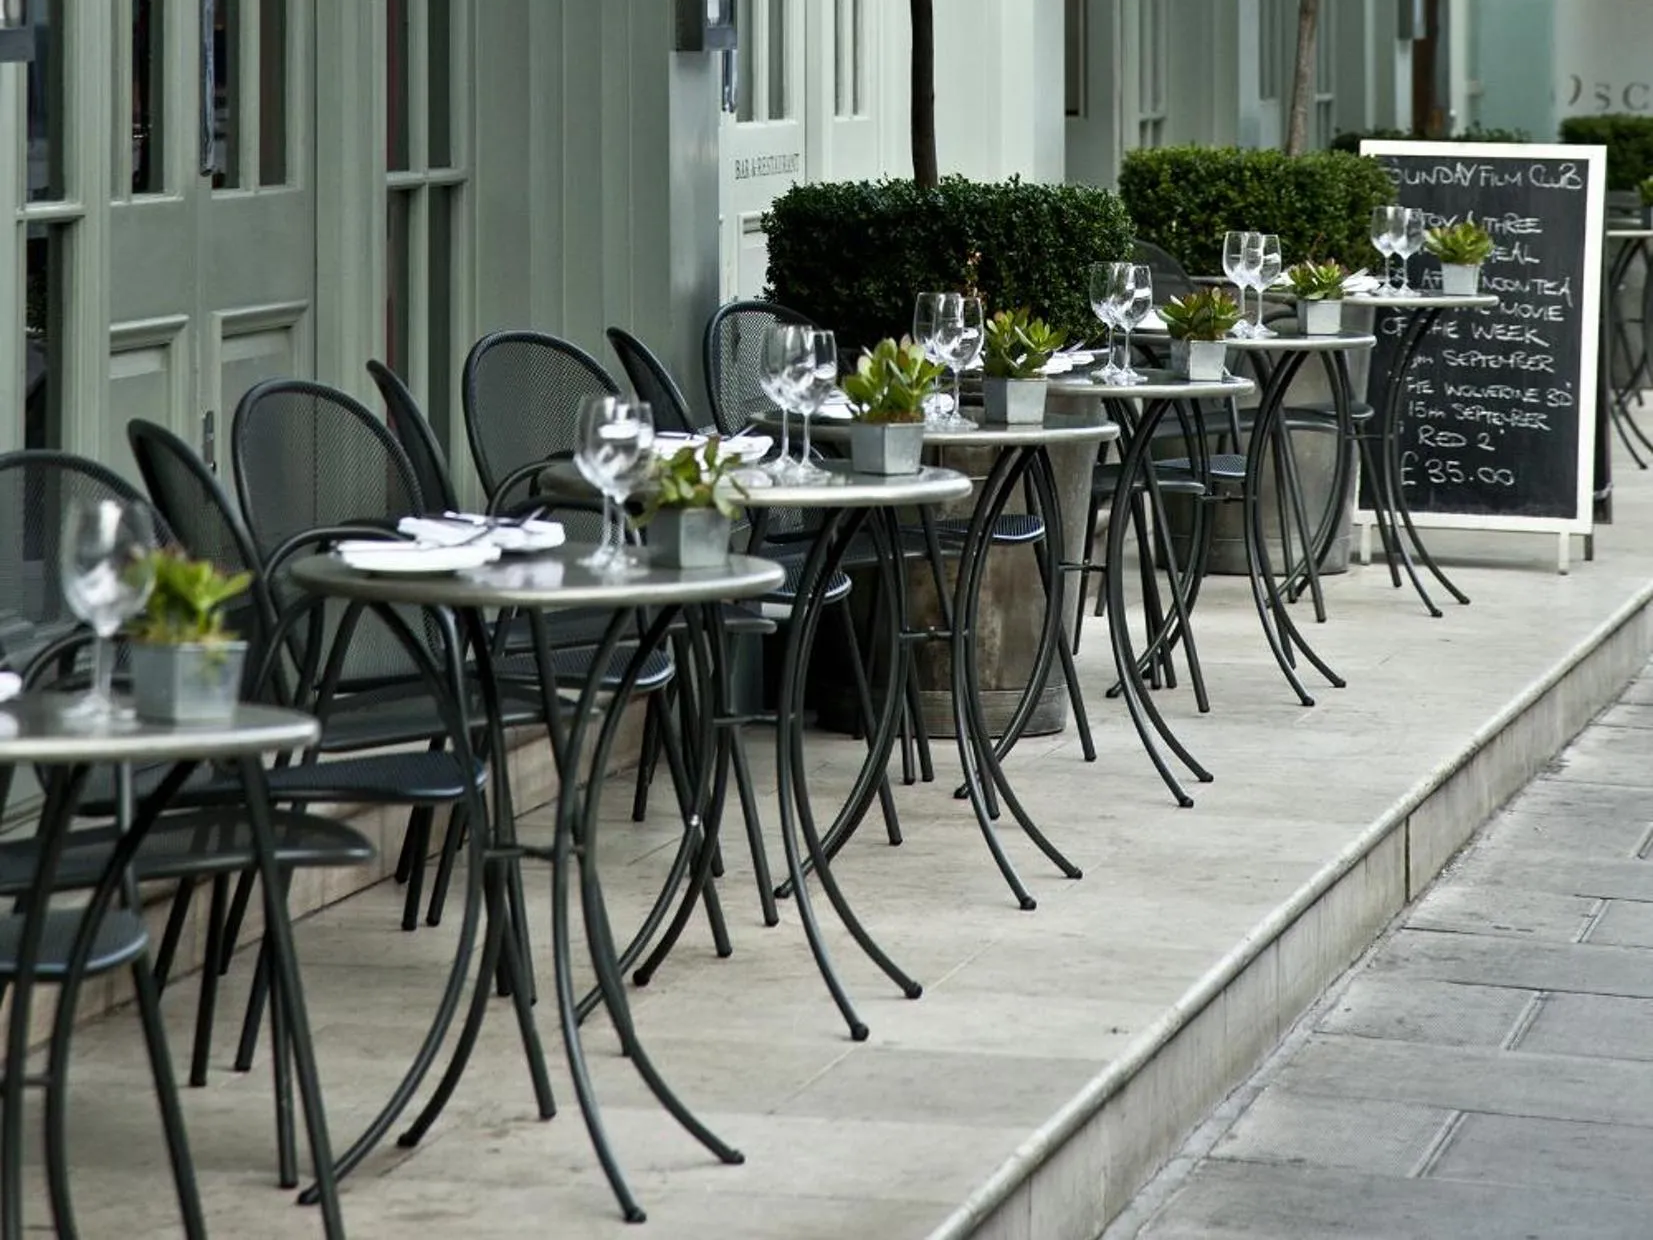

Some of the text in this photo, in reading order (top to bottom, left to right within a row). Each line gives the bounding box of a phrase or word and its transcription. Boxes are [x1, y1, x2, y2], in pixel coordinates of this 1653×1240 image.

[1482, 212, 1543, 234] THREE
[1486, 241, 1541, 265] EAL
[1500, 302, 1565, 322] MOVIE
[1381, 316, 1408, 337] OF
[1471, 322, 1551, 348] WEEK
[1442, 349, 1556, 374] SEPTEMBER
[1451, 403, 1552, 432] SEPTEMBER
